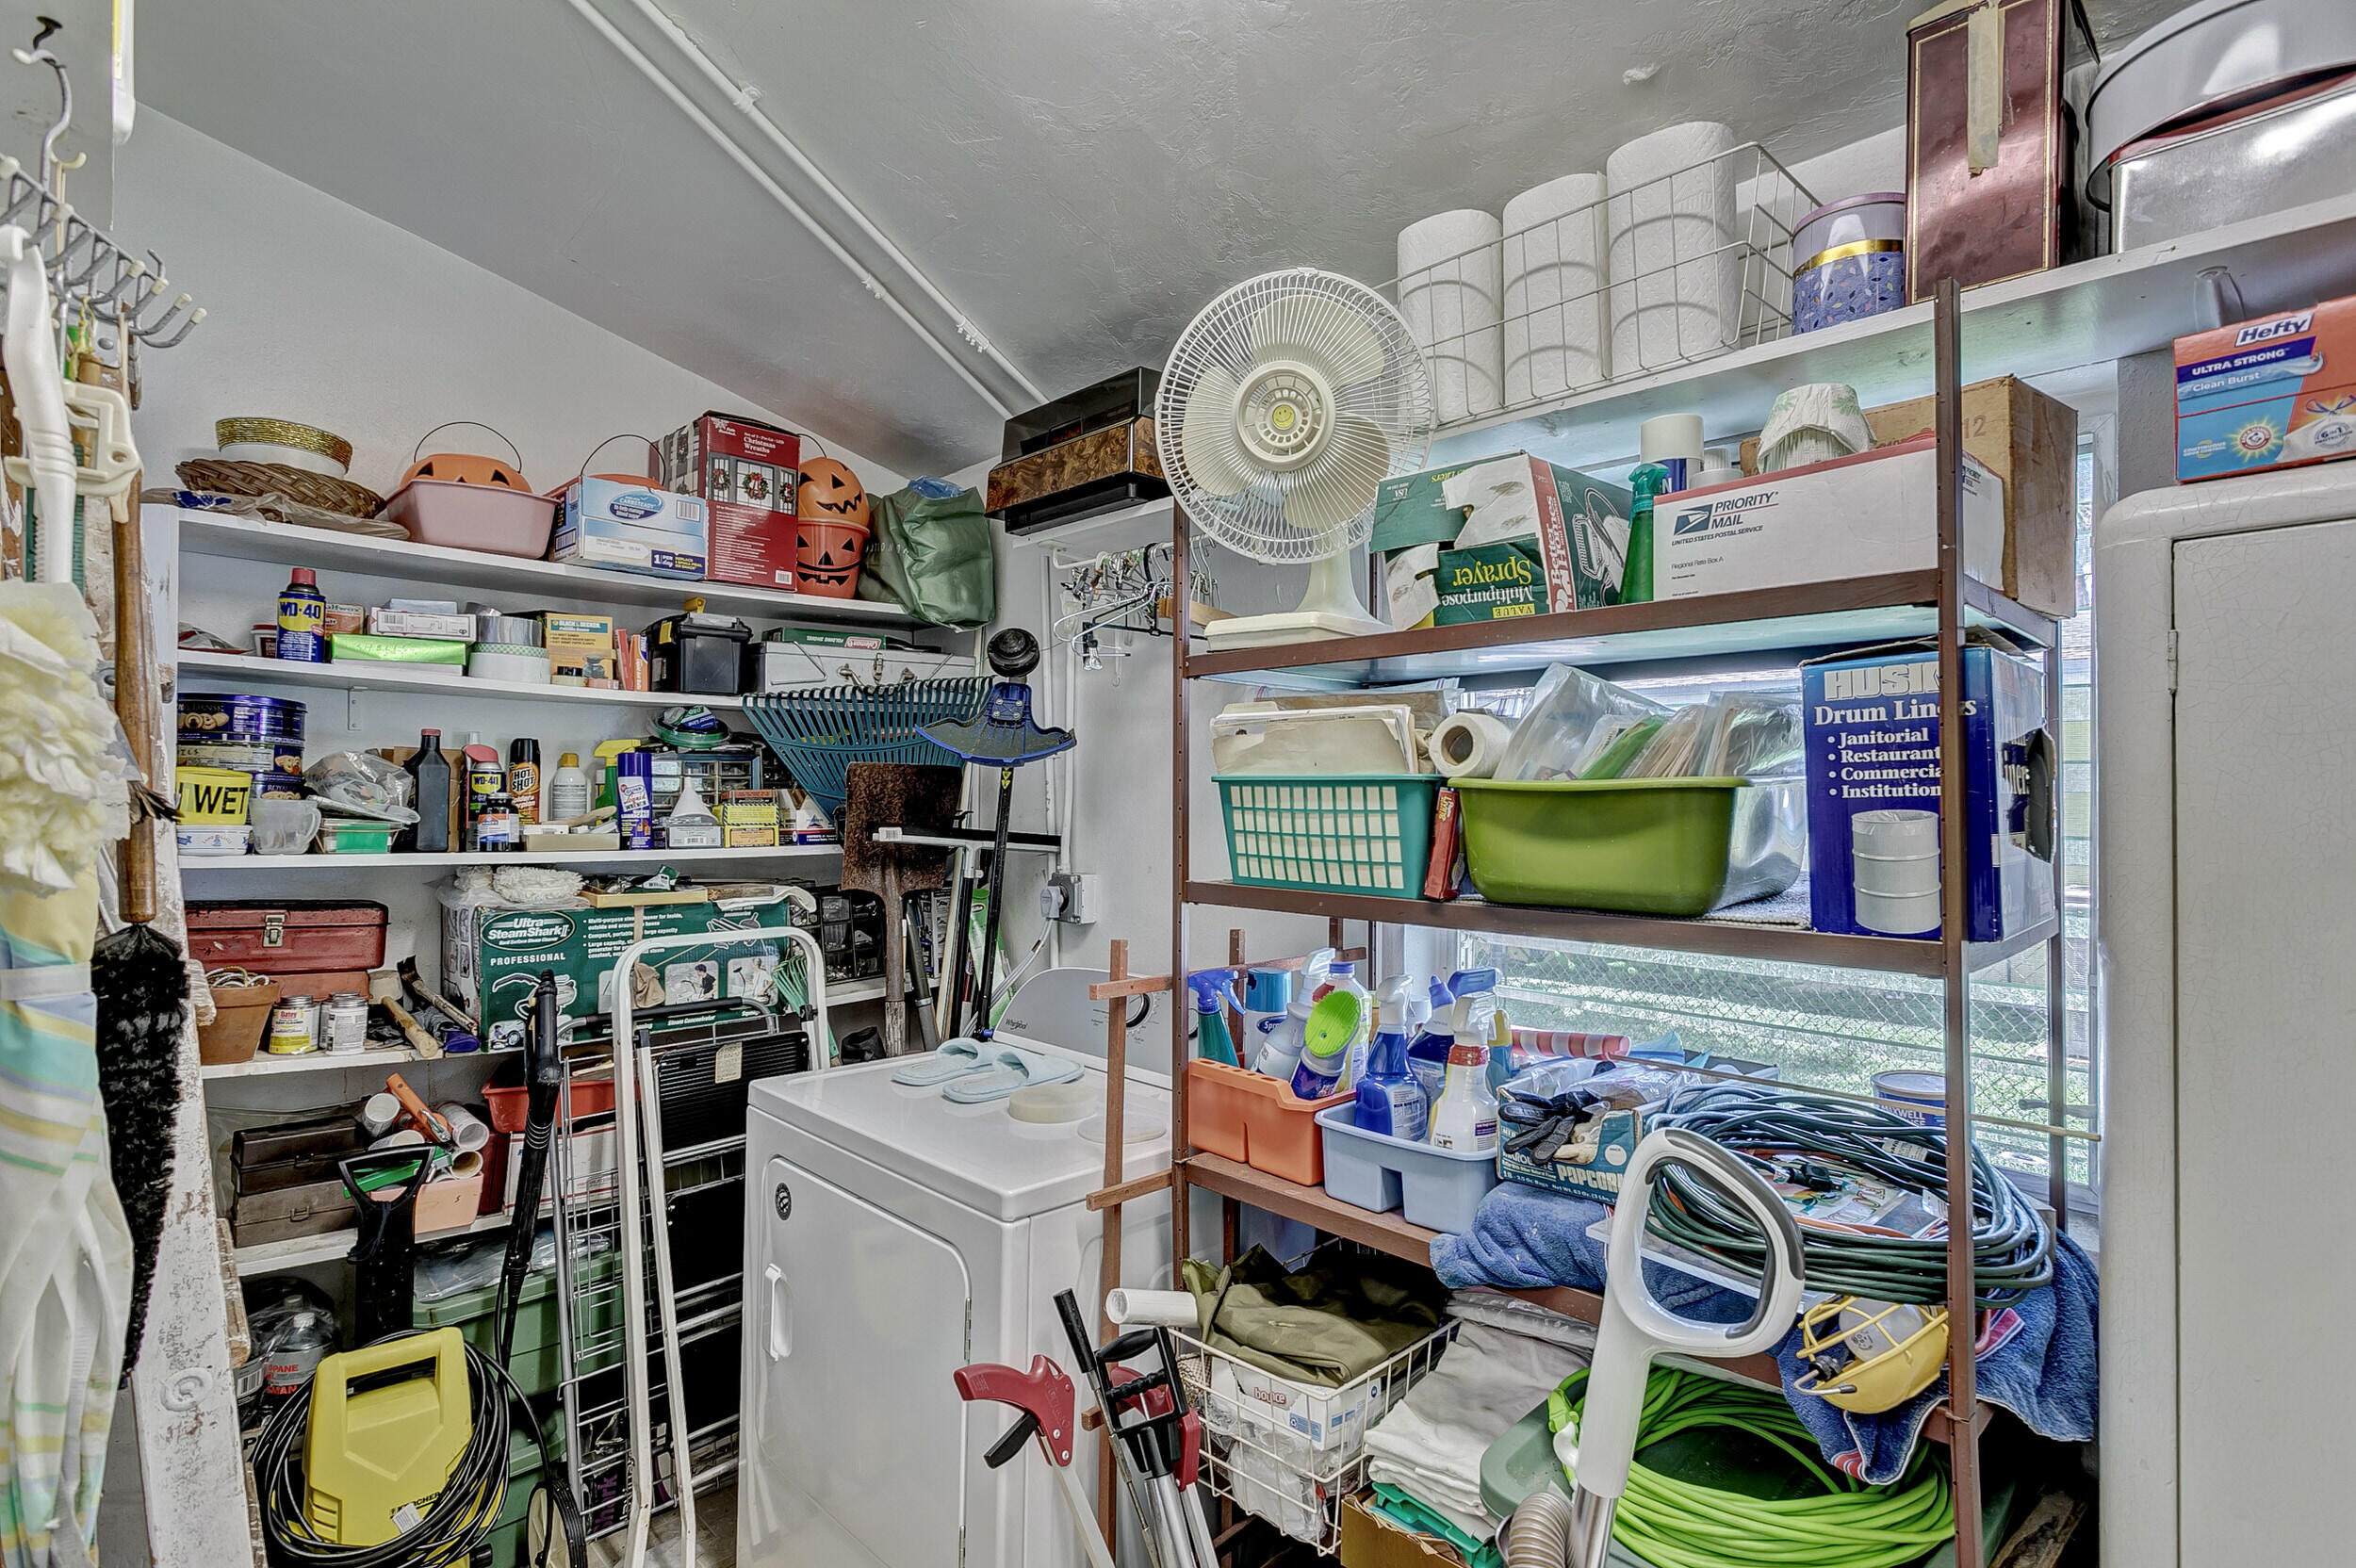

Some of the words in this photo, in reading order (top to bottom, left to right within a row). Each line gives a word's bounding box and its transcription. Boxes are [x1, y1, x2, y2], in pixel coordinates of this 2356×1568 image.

[2240, 318, 2308, 343] Hefty
[2191, 360, 2232, 376] ULTRA
[2233, 349, 2286, 367] STRONG
[2192, 379, 2225, 392] Clean
[2228, 371, 2260, 385] Burst
[744, 436, 777, 449] Christmas
[744, 443, 770, 453] Wreaths
[1715, 491, 1775, 514] PRIORITY
[1711, 514, 1743, 530] MAIL
[1671, 536, 1694, 547] UNITED
[1693, 533, 1715, 543] STATES
[1714, 530, 1737, 539] POSTAL
[1737, 525, 1764, 535] SERVICE
[653, 554, 661, 564] 1
[1546, 523, 1562, 586] Better
[1452, 556, 1532, 586] Sprayer
[1441, 584, 1533, 607] Multipurpose
[280, 601, 321, 619] WD-40
[1495, 605, 1533, 617] VALUE
[1824, 661, 1940, 701] HUSK
[1814, 704, 1888, 726] Drum
[1838, 727, 1930, 750] Janitorial
[473, 776, 499, 785] WD-40
[514, 768, 532, 780] HOT
[1841, 764, 1941, 782] Commercia
[512, 776, 535, 792] SHOT
[194, 782, 250, 814] WET
[513, 917, 544, 928] Ultra
[490, 952, 566, 967] PROFESSIONAL
